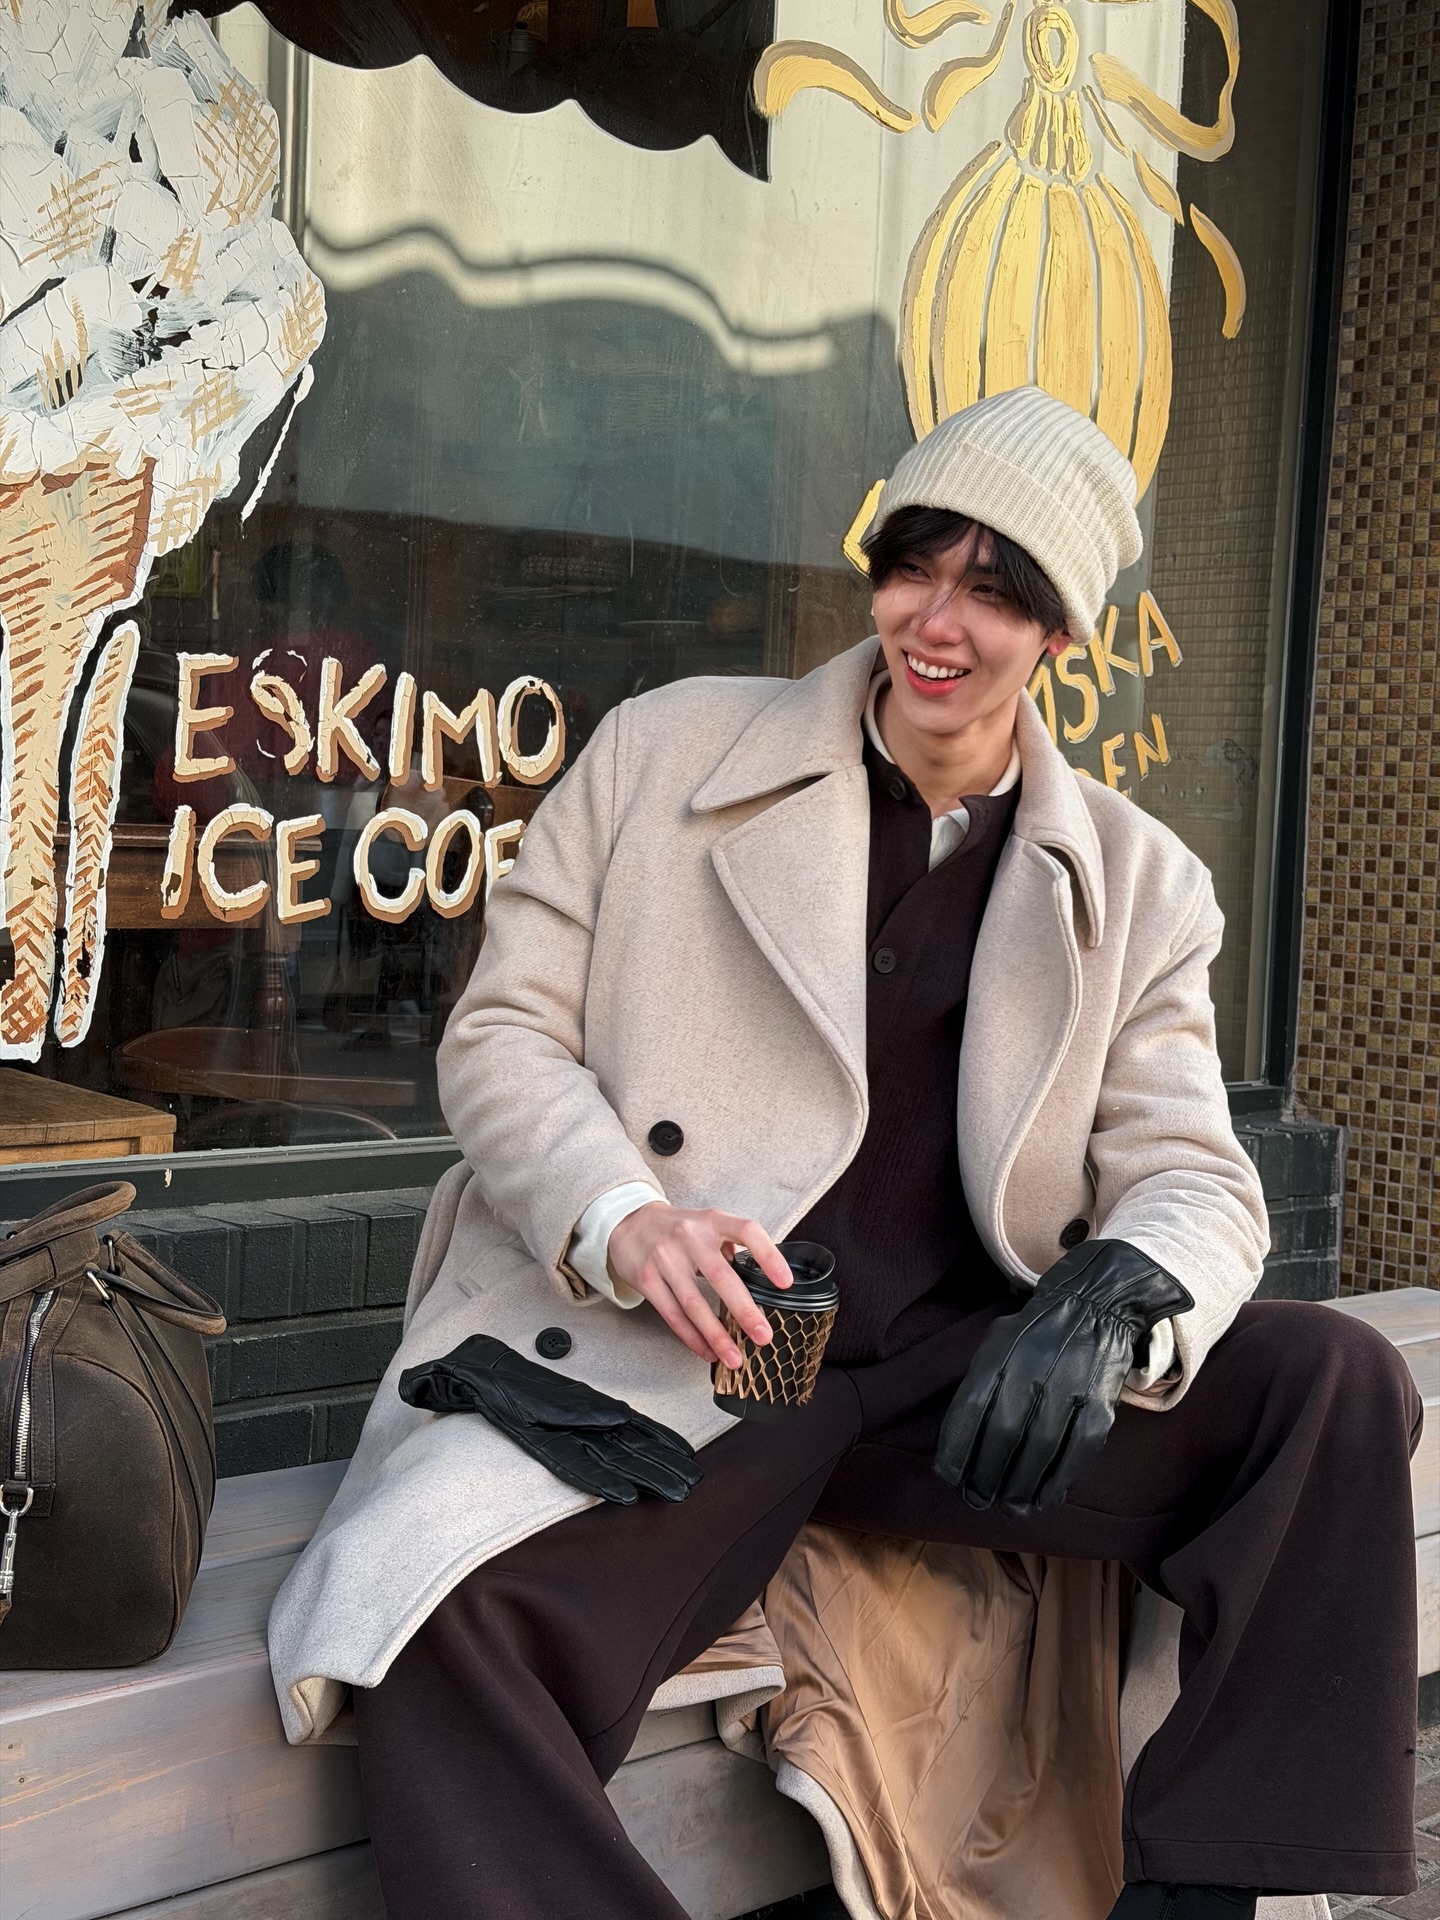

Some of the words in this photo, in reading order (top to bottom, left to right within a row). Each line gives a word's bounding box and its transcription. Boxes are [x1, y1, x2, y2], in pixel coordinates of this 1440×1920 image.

[172, 648, 566, 792] ESKIMO
[1073, 712, 1171, 800] EN
[160, 803, 332, 925] ICE
[353, 807, 527, 924] COF
